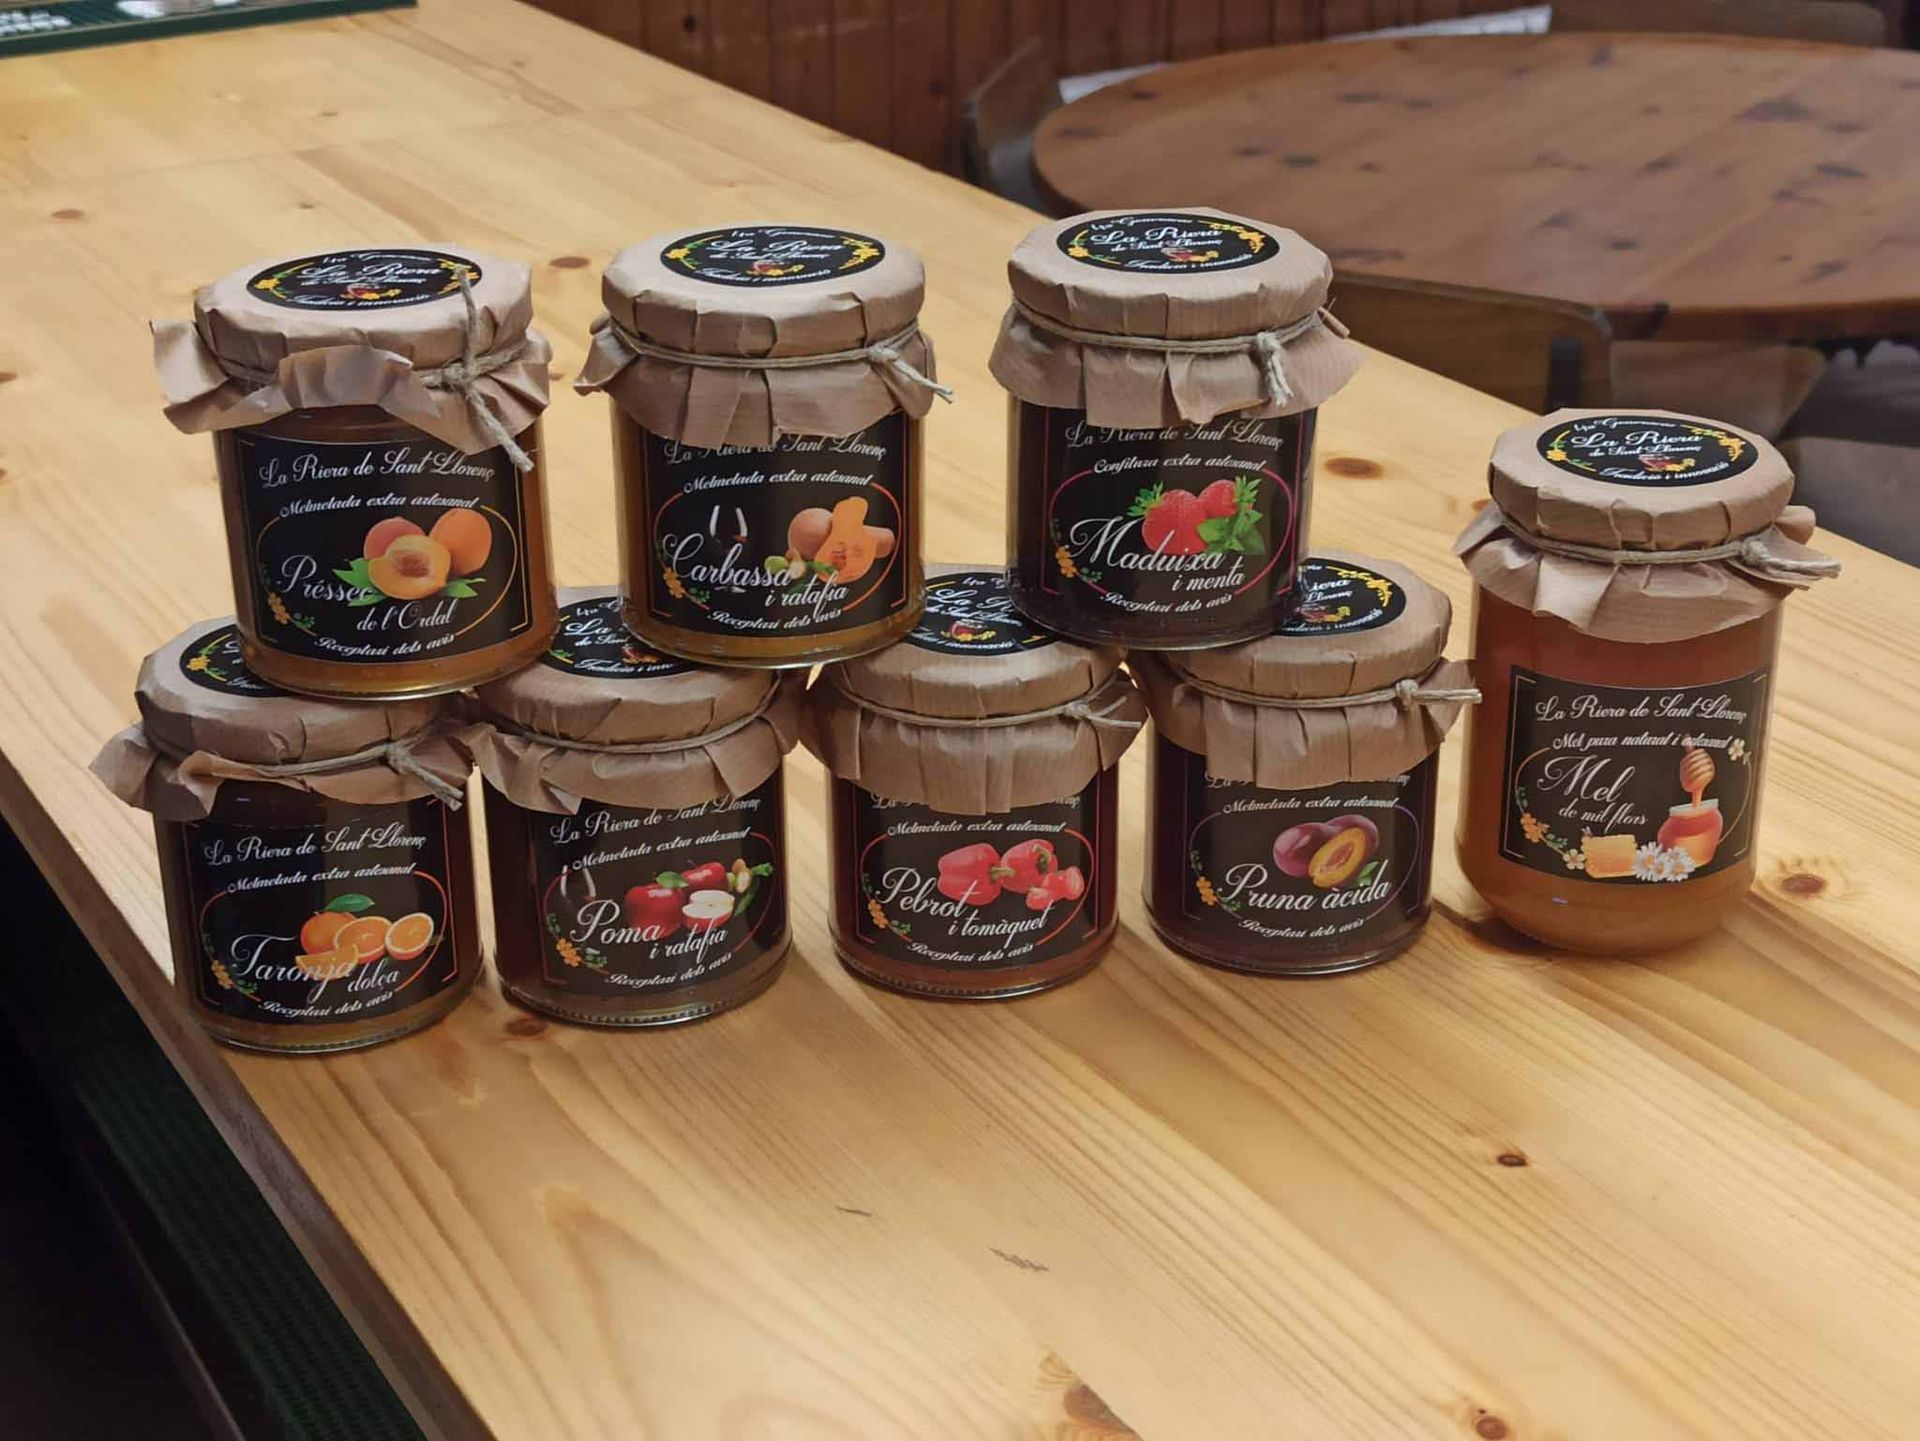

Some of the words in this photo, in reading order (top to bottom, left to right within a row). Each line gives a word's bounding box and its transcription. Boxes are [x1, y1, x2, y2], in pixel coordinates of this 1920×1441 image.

[706, 240, 755, 252] La
[1091, 230, 1138, 245] La
[1145, 227, 1222, 240] Riera
[297, 265, 346, 278] La
[829, 432, 888, 461] Llorenç
[1065, 420, 1093, 448] La
[1232, 419, 1283, 450] Llorenç
[1571, 432, 1619, 448] La
[1625, 431, 1703, 445] Riera
[664, 439, 691, 465] La
[1094, 456, 1158, 473] Confitura
[1162, 453, 1200, 466] extra
[259, 459, 287, 488] La
[293, 453, 350, 482] Riera
[353, 452, 374, 476] de
[380, 447, 432, 473] Sant
[430, 452, 495, 482] Llorenç
[684, 470, 765, 493] Melmelada
[769, 469, 806, 483] extra
[810, 470, 873, 486] artesanal
[279, 495, 361, 518] Melmelada
[366, 492, 405, 506] extra
[411, 493, 480, 509] artesanal
[1070, 515, 1226, 571] Maduixa
[662, 534, 794, 588] Carbassa
[1172, 576, 1182, 591] i
[1186, 557, 1245, 590] menta
[276, 555, 377, 602] Préssec
[765, 591, 775, 606] i
[781, 570, 849, 619] ratafia
[927, 589, 978, 605] La
[1175, 599, 1202, 611] dels
[1206, 593, 1233, 608] avis
[356, 607, 376, 631] de
[564, 618, 612, 635] La
[708, 610, 780, 629] Receptari
[784, 617, 812, 629] dels
[315, 637, 390, 656] Receptari
[392, 641, 422, 655] dels
[426, 633, 455, 650] avis
[1535, 696, 1565, 721] La
[1571, 694, 1626, 719] Riera
[1629, 697, 1649, 717] de
[1653, 694, 1699, 718] Sant
[1696, 694, 1747, 724] Llorenç
[1553, 732, 1586, 750] Mel
[1580, 735, 1618, 750] pura
[1621, 731, 1674, 746] natural
[1537, 754, 1636, 802] Mel
[1223, 798, 1300, 814] Melmelada
[1305, 796, 1340, 808] extra
[1558, 798, 1579, 817] de
[1581, 803, 1610, 823] mil
[1604, 802, 1647, 833] flors
[551, 817, 580, 845] La
[585, 811, 639, 836] Riera
[644, 809, 661, 825] de
[888, 821, 962, 836] Melmelada
[967, 820, 1002, 832] extra
[1006, 820, 1066, 833] artesanal
[204, 839, 232, 866] La
[237, 836, 292, 861] Riera
[295, 833, 316, 856] de
[321, 826, 370, 853] Sant
[370, 822, 427, 850] Llorenç
[573, 843, 652, 870] Melmelada
[656, 837, 692, 852] extra
[695, 826, 750, 846] artesanal
[227, 873, 306, 893] Melmelada
[311, 867, 350, 881] extra
[354, 863, 416, 877] artesanal
[875, 866, 980, 917] Pebrot
[1217, 863, 1318, 911] Pruna
[1322, 859, 1391, 909] àcida
[570, 899, 665, 944] Poma
[948, 921, 958, 935] i
[961, 899, 1055, 948] tomàquet
[1238, 919, 1306, 938] Receptari
[1310, 926, 1336, 938] dels
[1339, 918, 1365, 933] avis
[650, 943, 659, 959] i
[665, 918, 728, 963] ratafia
[907, 941, 974, 962] Receptari
[977, 951, 1004, 962] dels
[1008, 943, 1035, 958] avis
[231, 933, 354, 1003] Taronja
[347, 957, 399, 993] dolça
[605, 974, 676, 988] Receptari
[679, 966, 706, 981] dels
[709, 952, 733, 969] avis
[259, 1000, 332, 1018] Receptari
[335, 1002, 362, 1015] dels
[366, 991, 393, 1007] avis
